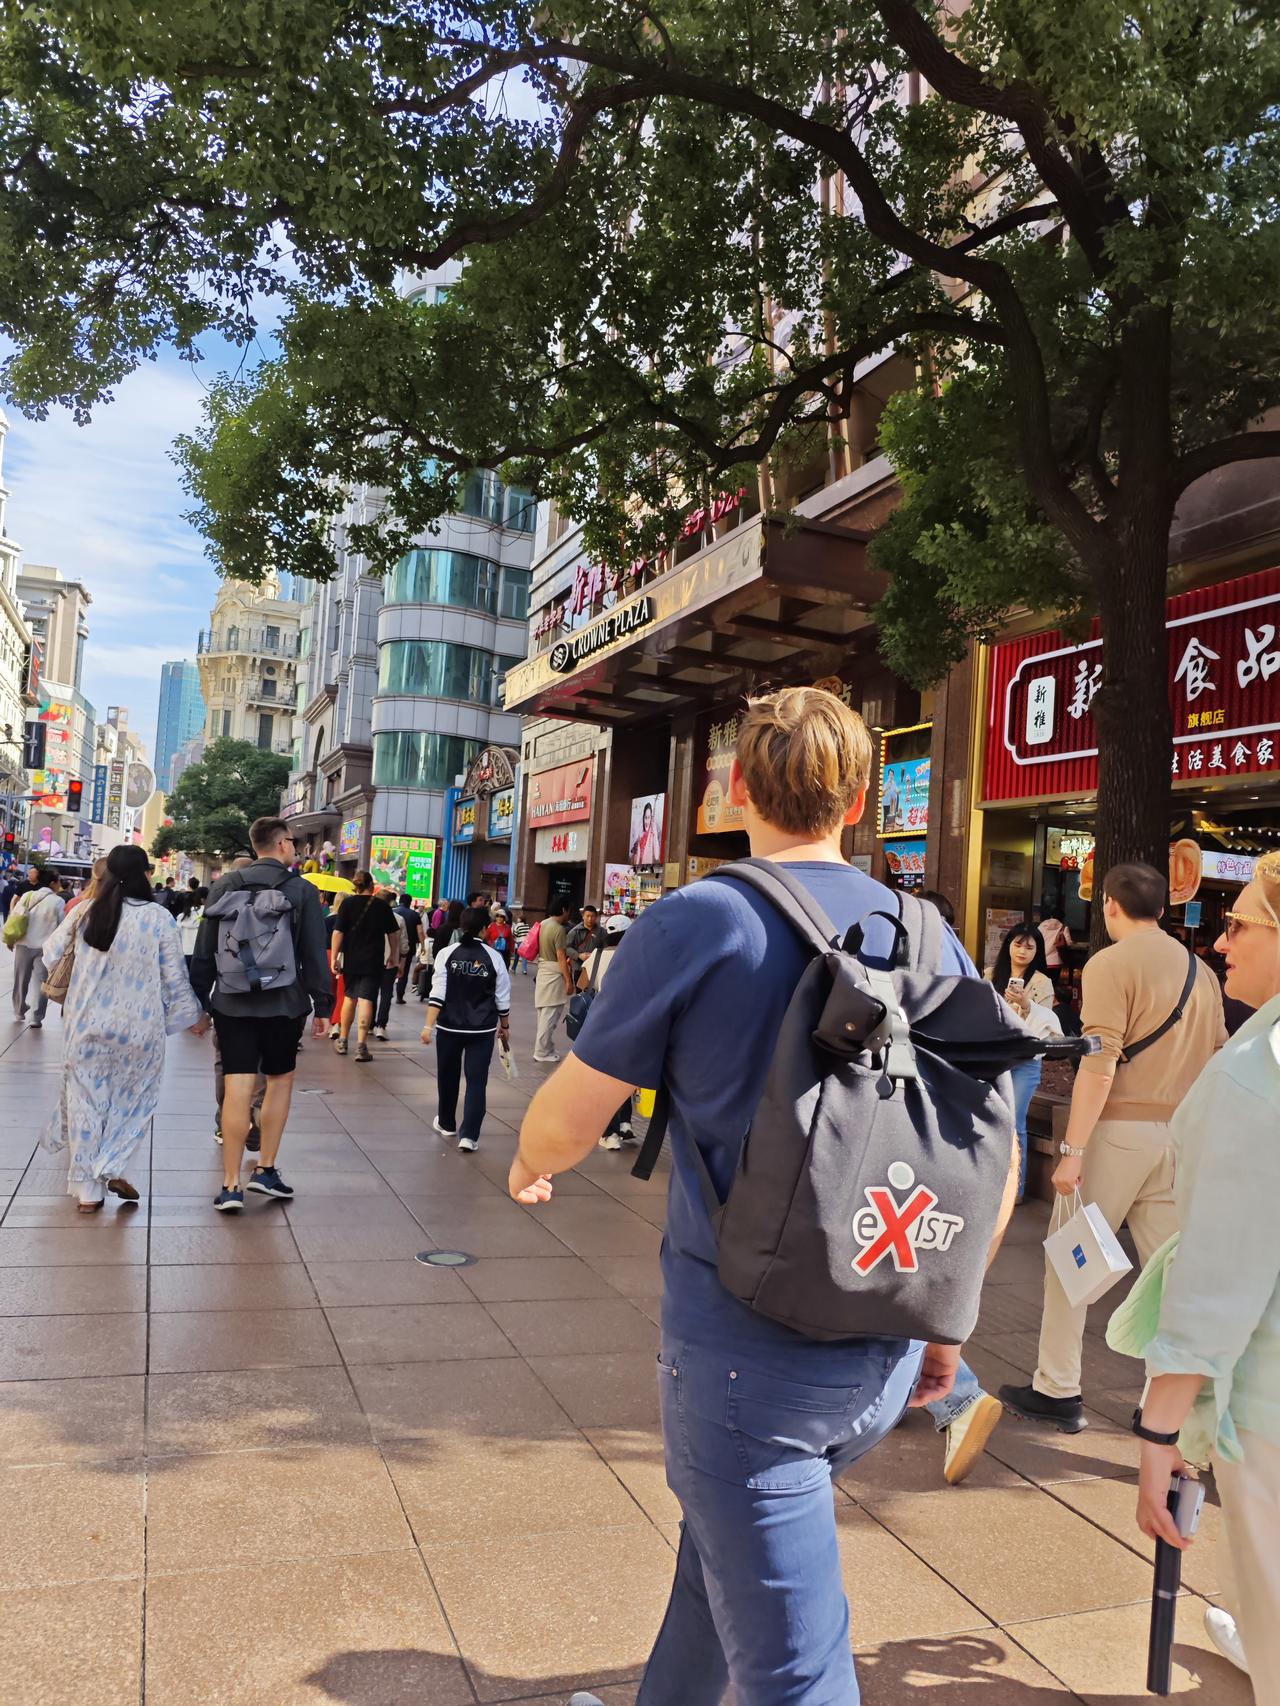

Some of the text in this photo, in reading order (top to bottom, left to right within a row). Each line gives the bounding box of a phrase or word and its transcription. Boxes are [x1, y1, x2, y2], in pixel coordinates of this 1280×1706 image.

[572, 596, 649, 659] CROWNE PLAZA
[1034, 685, 1047, 728] 新雅
[1187, 709, 1225, 729] 旗舰店
